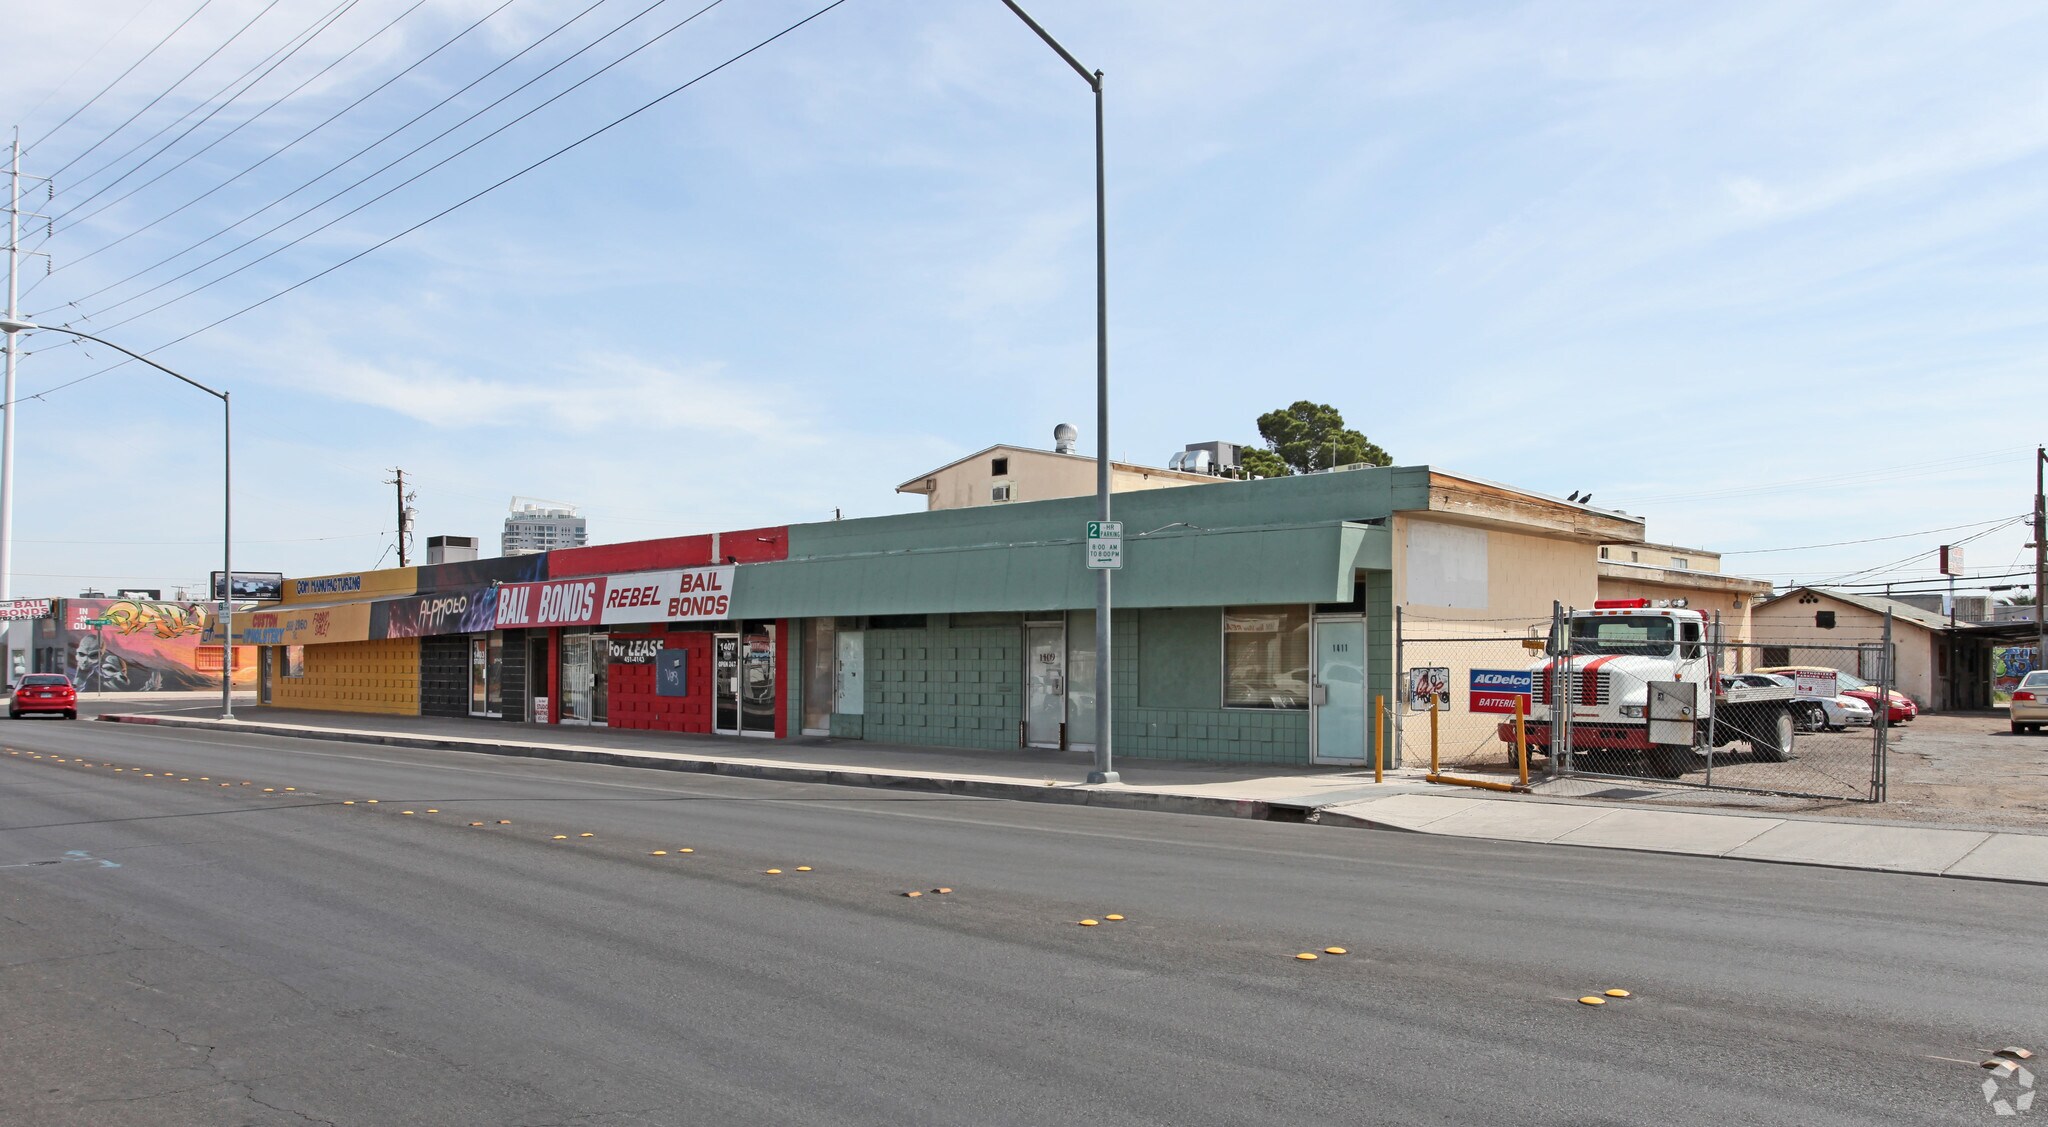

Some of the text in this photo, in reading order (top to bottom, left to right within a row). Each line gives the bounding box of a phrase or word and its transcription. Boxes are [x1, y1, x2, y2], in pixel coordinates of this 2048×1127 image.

[1090, 523, 1098, 537] 2
[680, 571, 722, 593] BAIL
[496, 581, 596, 625] BAIL BONDS
[606, 585, 662, 609] REBEL
[14, 600, 47, 609] BAIL
[667, 595, 728, 616] BONDS
[0, 607, 50, 617] BONDS
[252, 613, 279, 629] CUSTOM
[608, 640, 626, 657] For
[720, 642, 735, 651] 1407
[1332, 644, 1348, 653] 1411
[1040, 652, 1056, 662] 1409
[1474, 674, 1531, 686] ACDelco
[1478, 698, 1516, 708] BATTERIE
